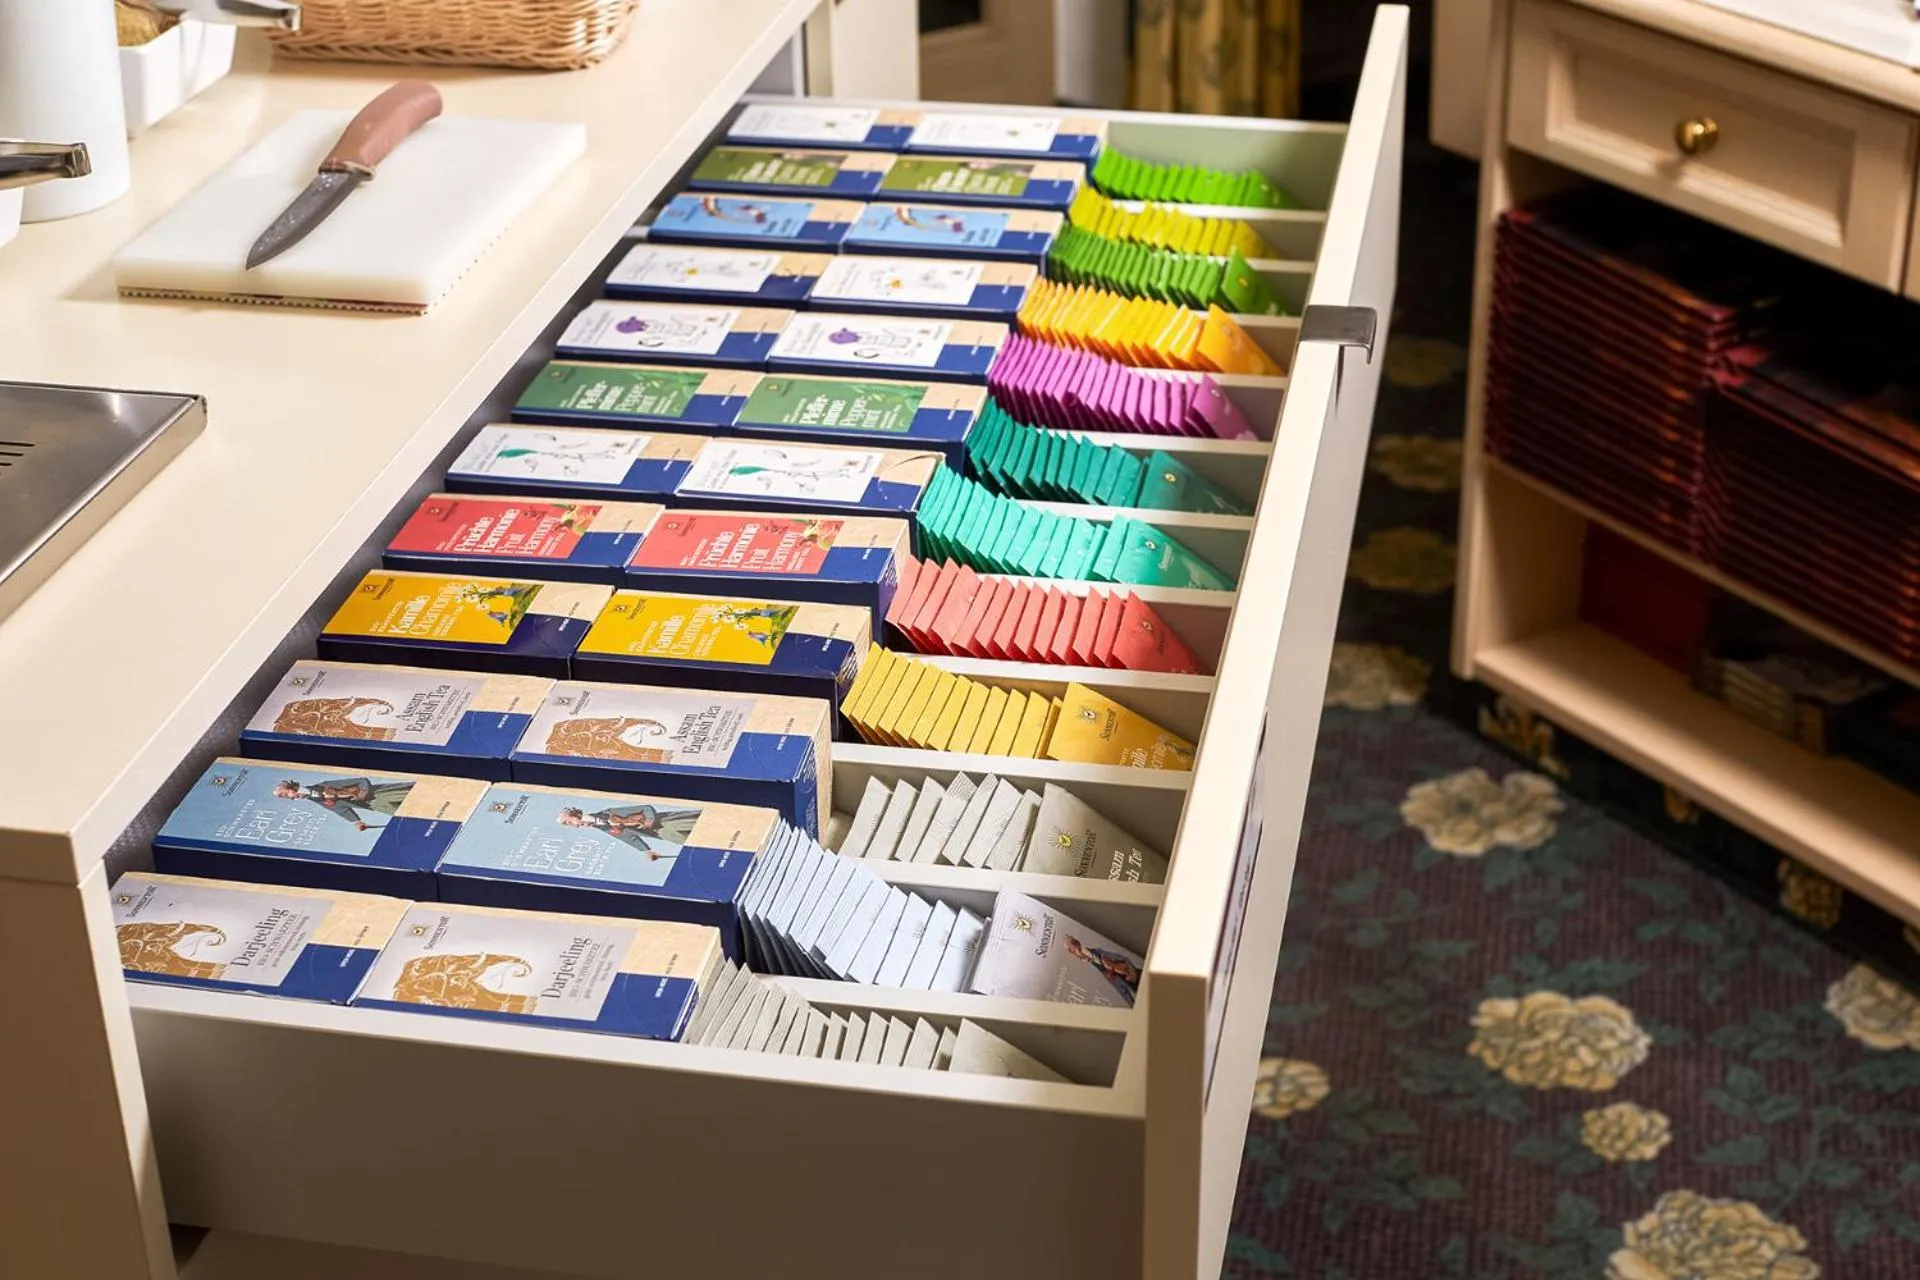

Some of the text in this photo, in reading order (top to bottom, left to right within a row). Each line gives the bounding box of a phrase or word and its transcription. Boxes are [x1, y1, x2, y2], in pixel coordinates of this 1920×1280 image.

[472, 509, 520, 552] Harmonie
[718, 523, 760, 568] Harmonie
[388, 595, 431, 634] Kamille
[647, 616, 685, 654] Kamille
[396, 693, 426, 721] Assam
[406, 685, 450, 732] English Tea
[670, 713, 698, 743] Assam
[682, 705, 721, 754] English Tea
[236, 809, 277, 840] Earl
[265, 807, 311, 843] Grey
[523, 838, 564, 868] Earl
[554, 836, 600, 871] Grey
[230, 907, 289, 967] Darjeeling
[1035, 913, 1054, 958] SONNENTOR
[541, 936, 591, 999] Darjeeling
